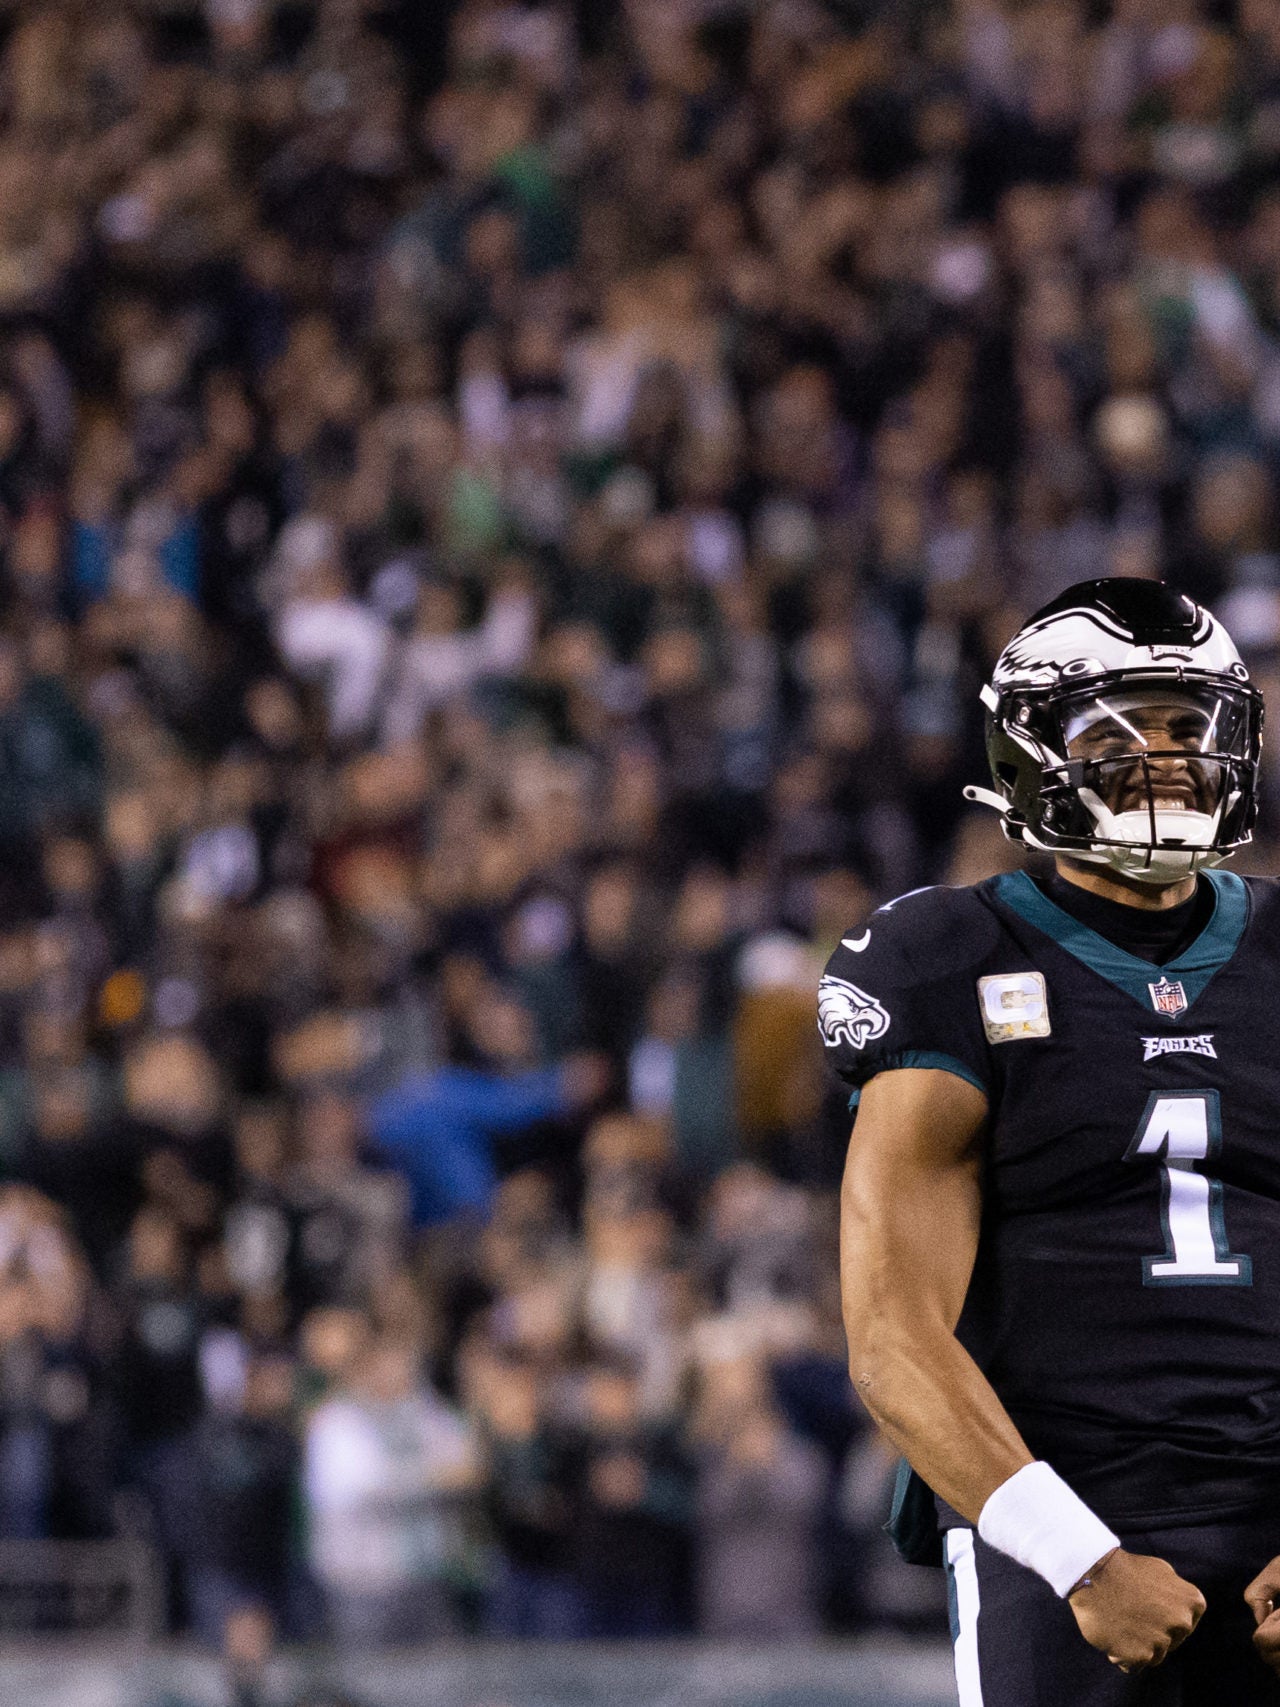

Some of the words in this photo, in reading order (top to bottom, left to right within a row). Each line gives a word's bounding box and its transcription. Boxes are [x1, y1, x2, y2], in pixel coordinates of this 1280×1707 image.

[1157, 994, 1184, 1011] NFL
[1140, 1035, 1217, 1061] EAGLES
[1125, 1089, 1251, 1286] 1
